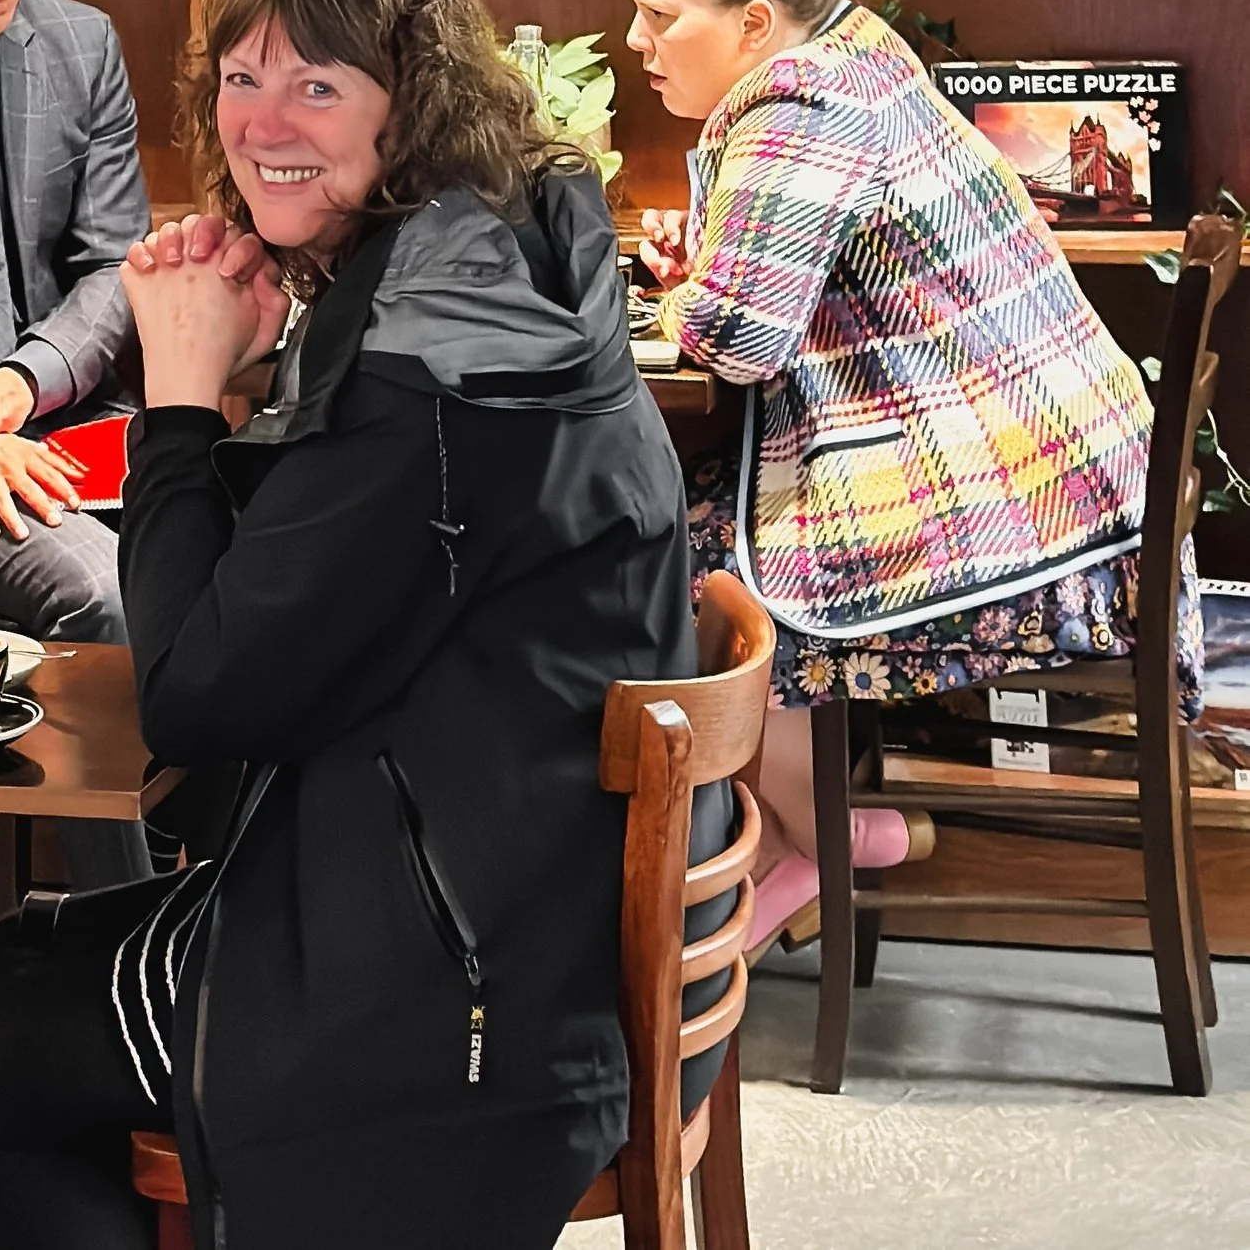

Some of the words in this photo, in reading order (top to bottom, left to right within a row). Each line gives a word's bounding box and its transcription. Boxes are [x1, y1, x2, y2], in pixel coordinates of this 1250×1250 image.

[944, 76, 1003, 95] 1000
[1009, 75, 1078, 94] PIECE
[1083, 74, 1177, 93] PUZZLE
